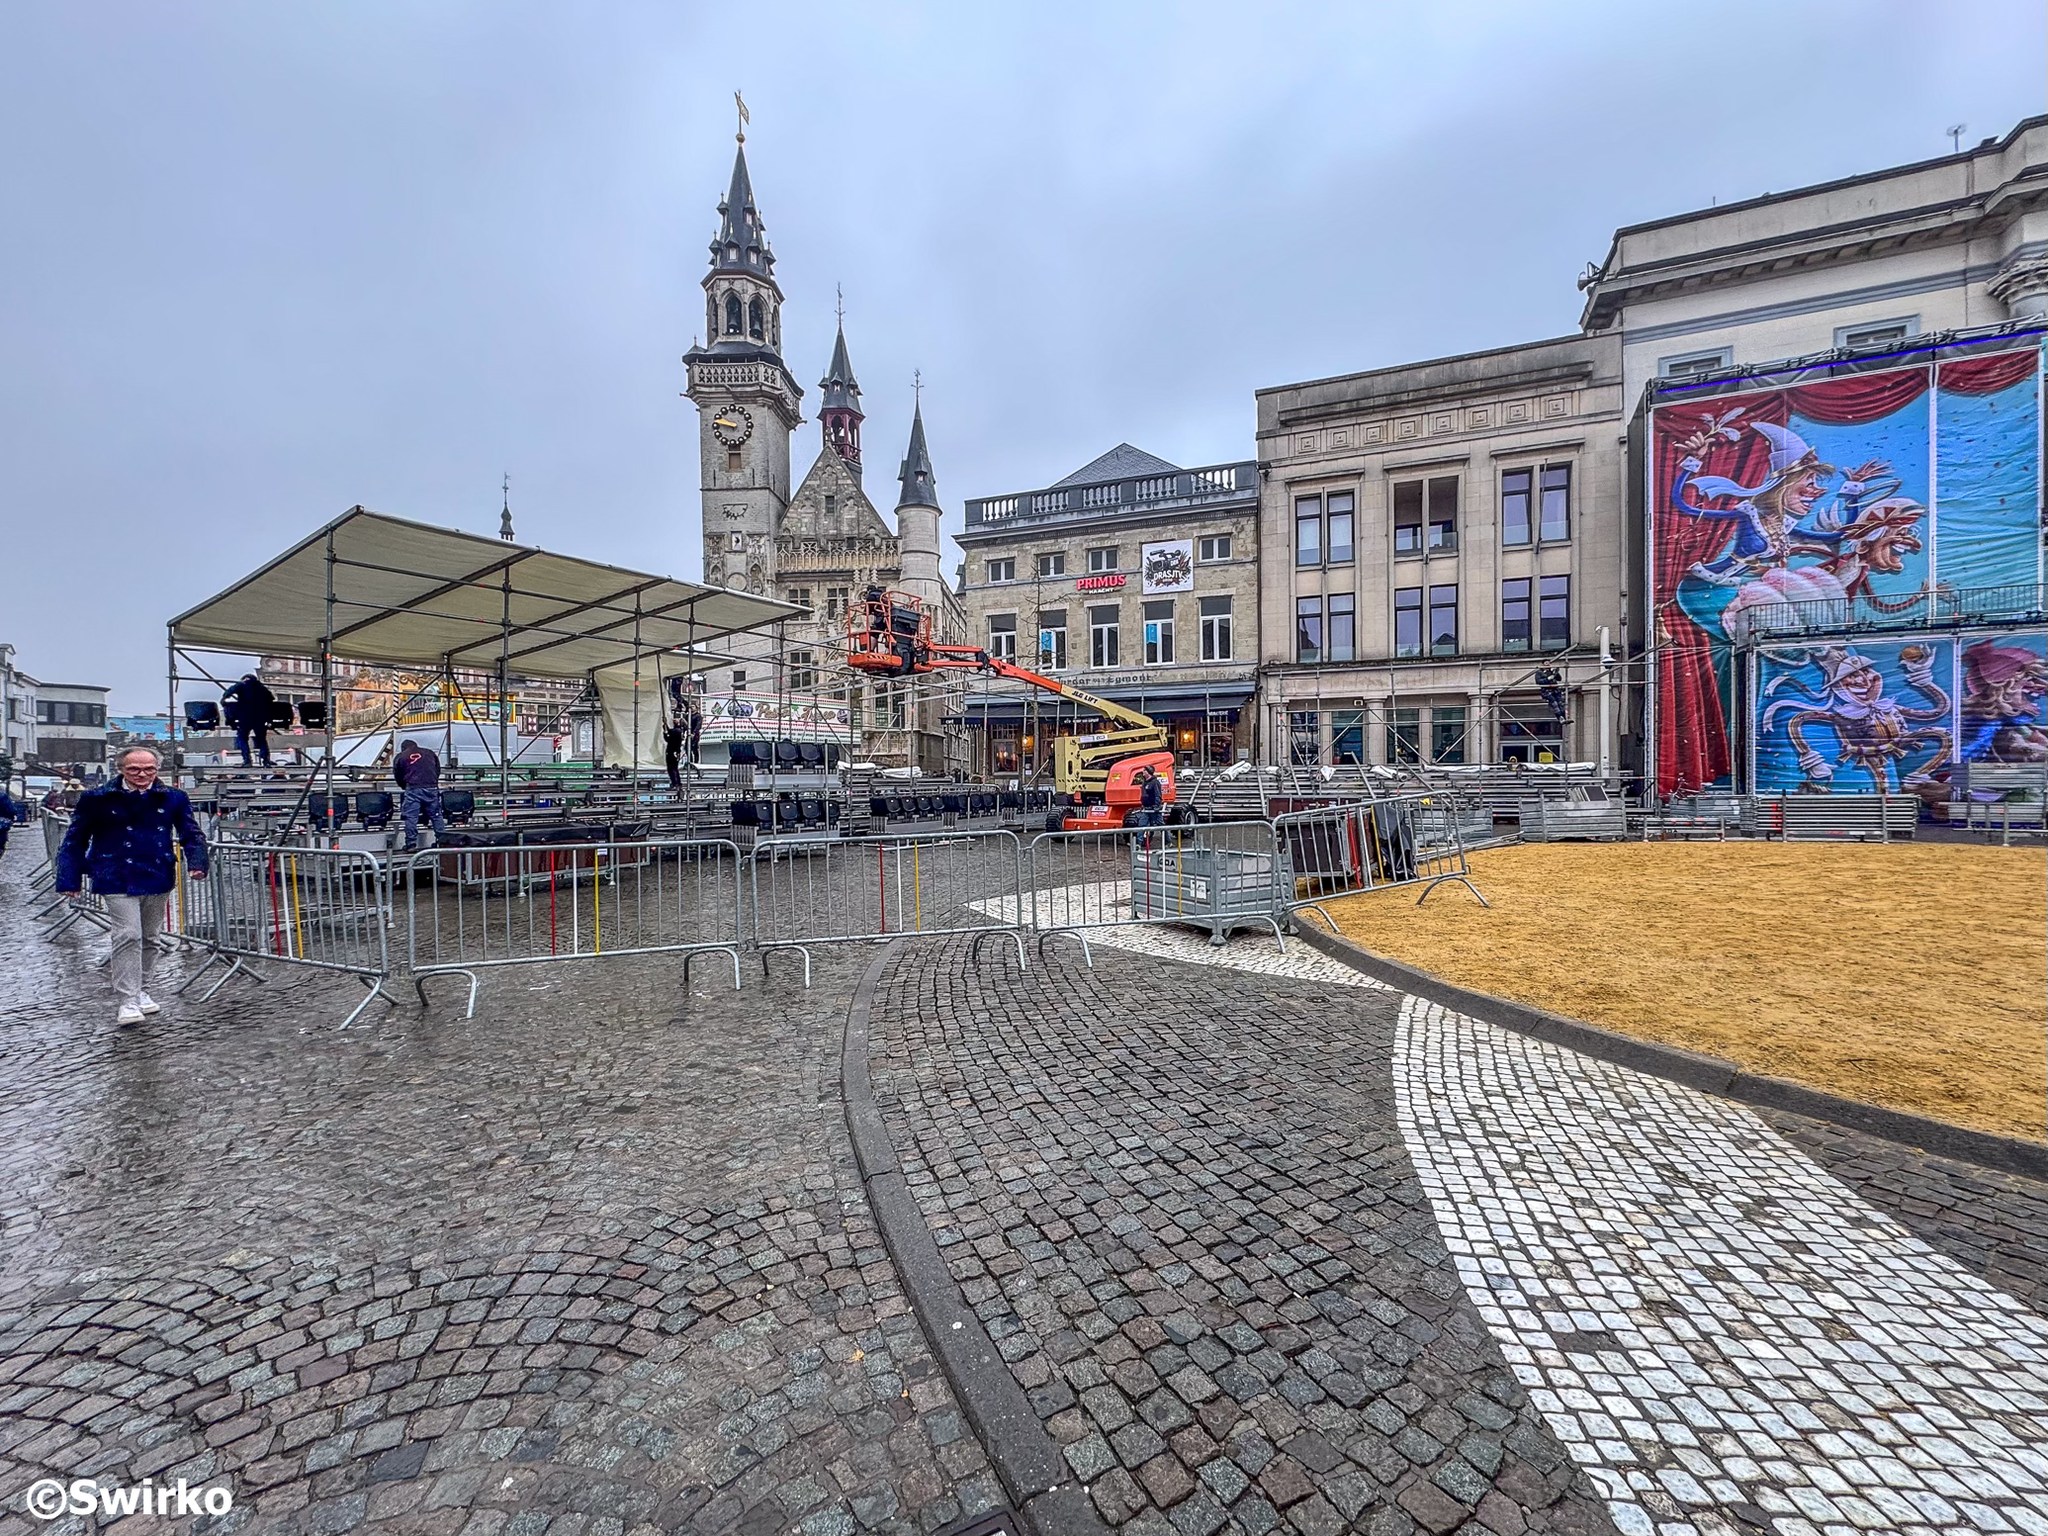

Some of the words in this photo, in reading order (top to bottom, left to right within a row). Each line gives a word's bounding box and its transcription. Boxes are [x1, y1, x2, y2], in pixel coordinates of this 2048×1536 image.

[1076, 575, 1127, 589] PRIMUS
[1072, 690, 1084, 699] JLG
[1084, 694, 1098, 704] LIFT
